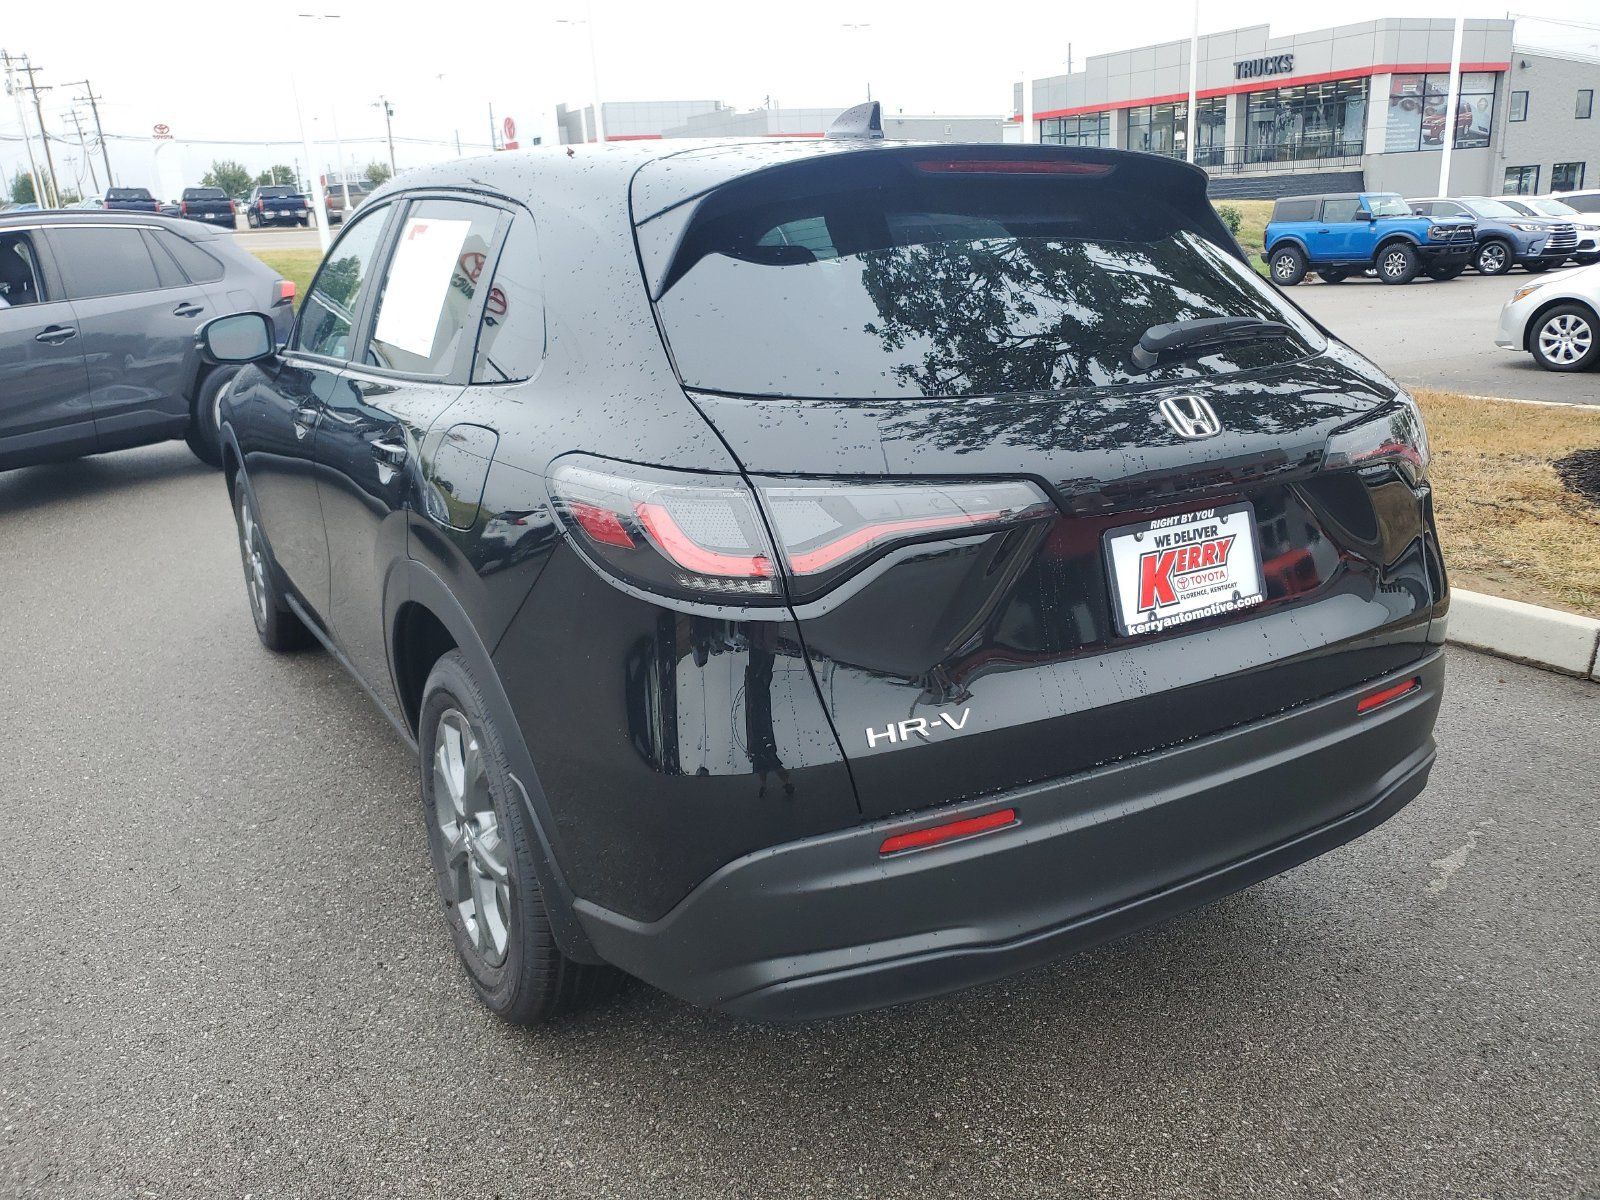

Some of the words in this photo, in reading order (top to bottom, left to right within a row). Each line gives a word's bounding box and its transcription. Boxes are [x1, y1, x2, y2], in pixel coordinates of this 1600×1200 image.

[1233, 54, 1294, 79] TRUCKS
[1150, 516, 1180, 529] RIGHT
[1181, 513, 1195, 524] BY
[1196, 509, 1214, 520] YOU
[1154, 536, 1171, 548] WE
[1174, 525, 1219, 543] DELIVER
[1138, 535, 1235, 612] KERRY
[1190, 570, 1226, 586] TOYOTA
[1210, 581, 1238, 593] KENTUCKY
[1127, 593, 1263, 636] kerryautomotive.com
[865, 707, 971, 748] HR-V
